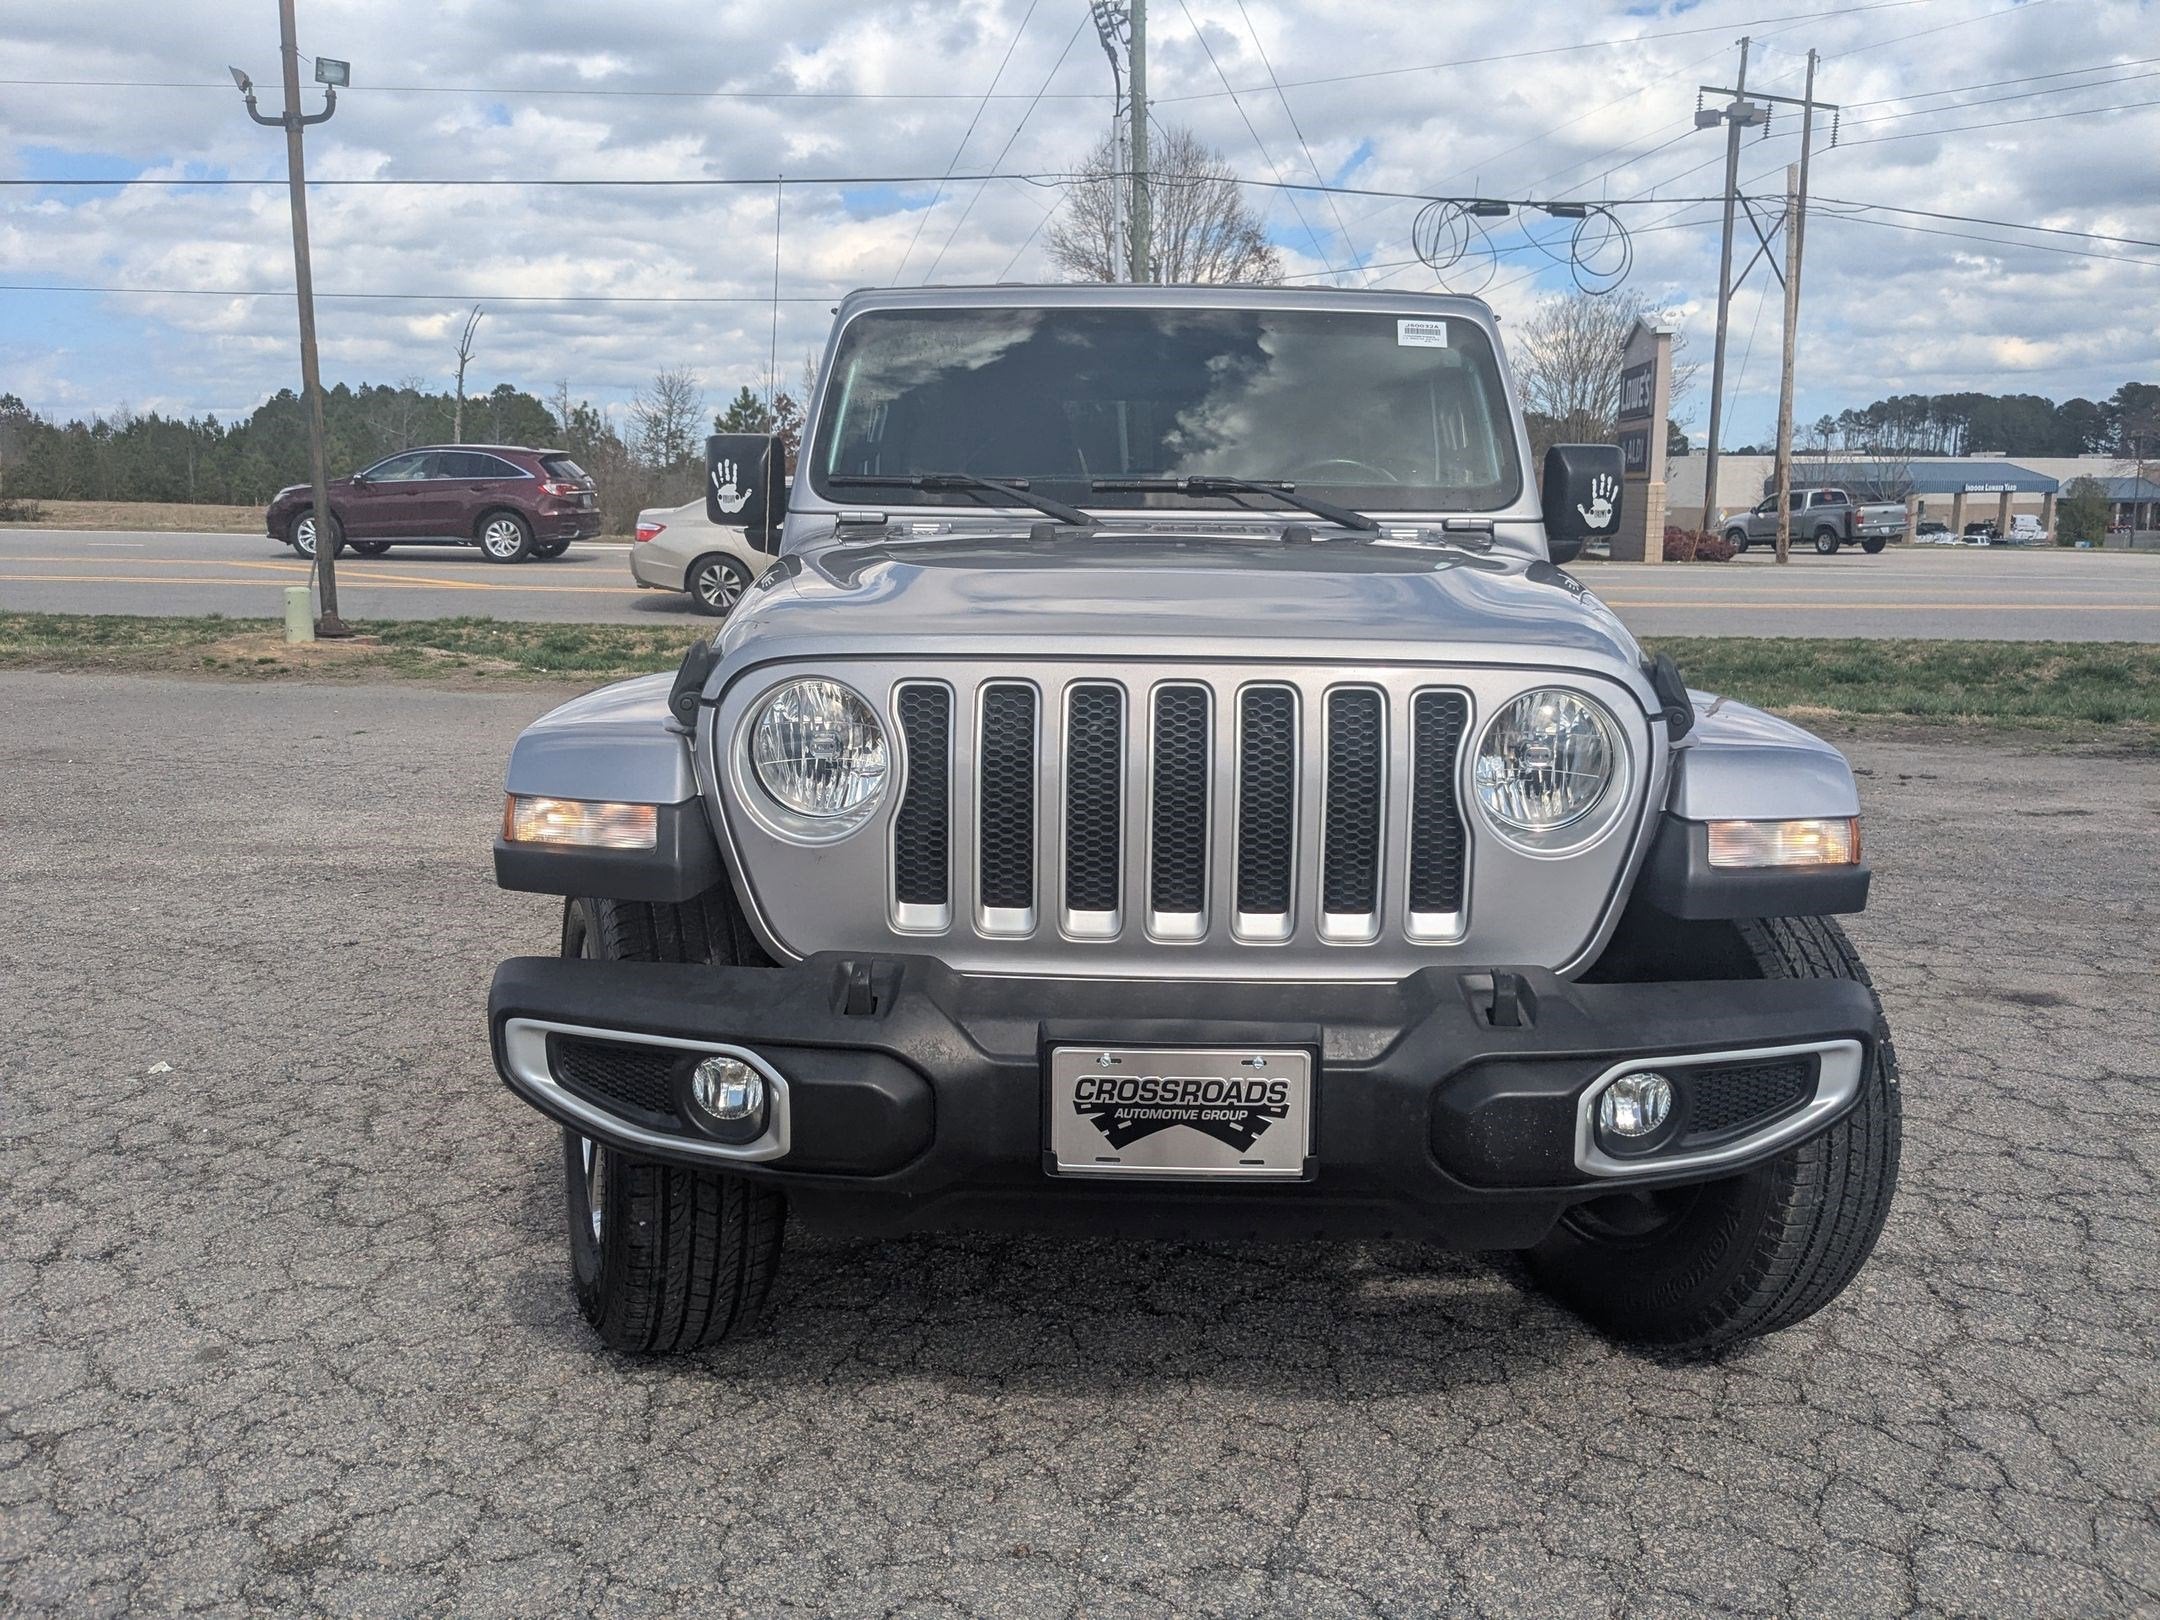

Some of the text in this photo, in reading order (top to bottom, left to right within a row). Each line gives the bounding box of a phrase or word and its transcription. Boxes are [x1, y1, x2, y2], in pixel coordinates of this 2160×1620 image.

[1621, 369, 1650, 411] LOWE'S
[1627, 438, 1644, 464] ALDI
[1074, 1077, 1289, 1105] CROSSROADS
[1114, 1108, 1249, 1121] AUTOMOTIVE GROUP
